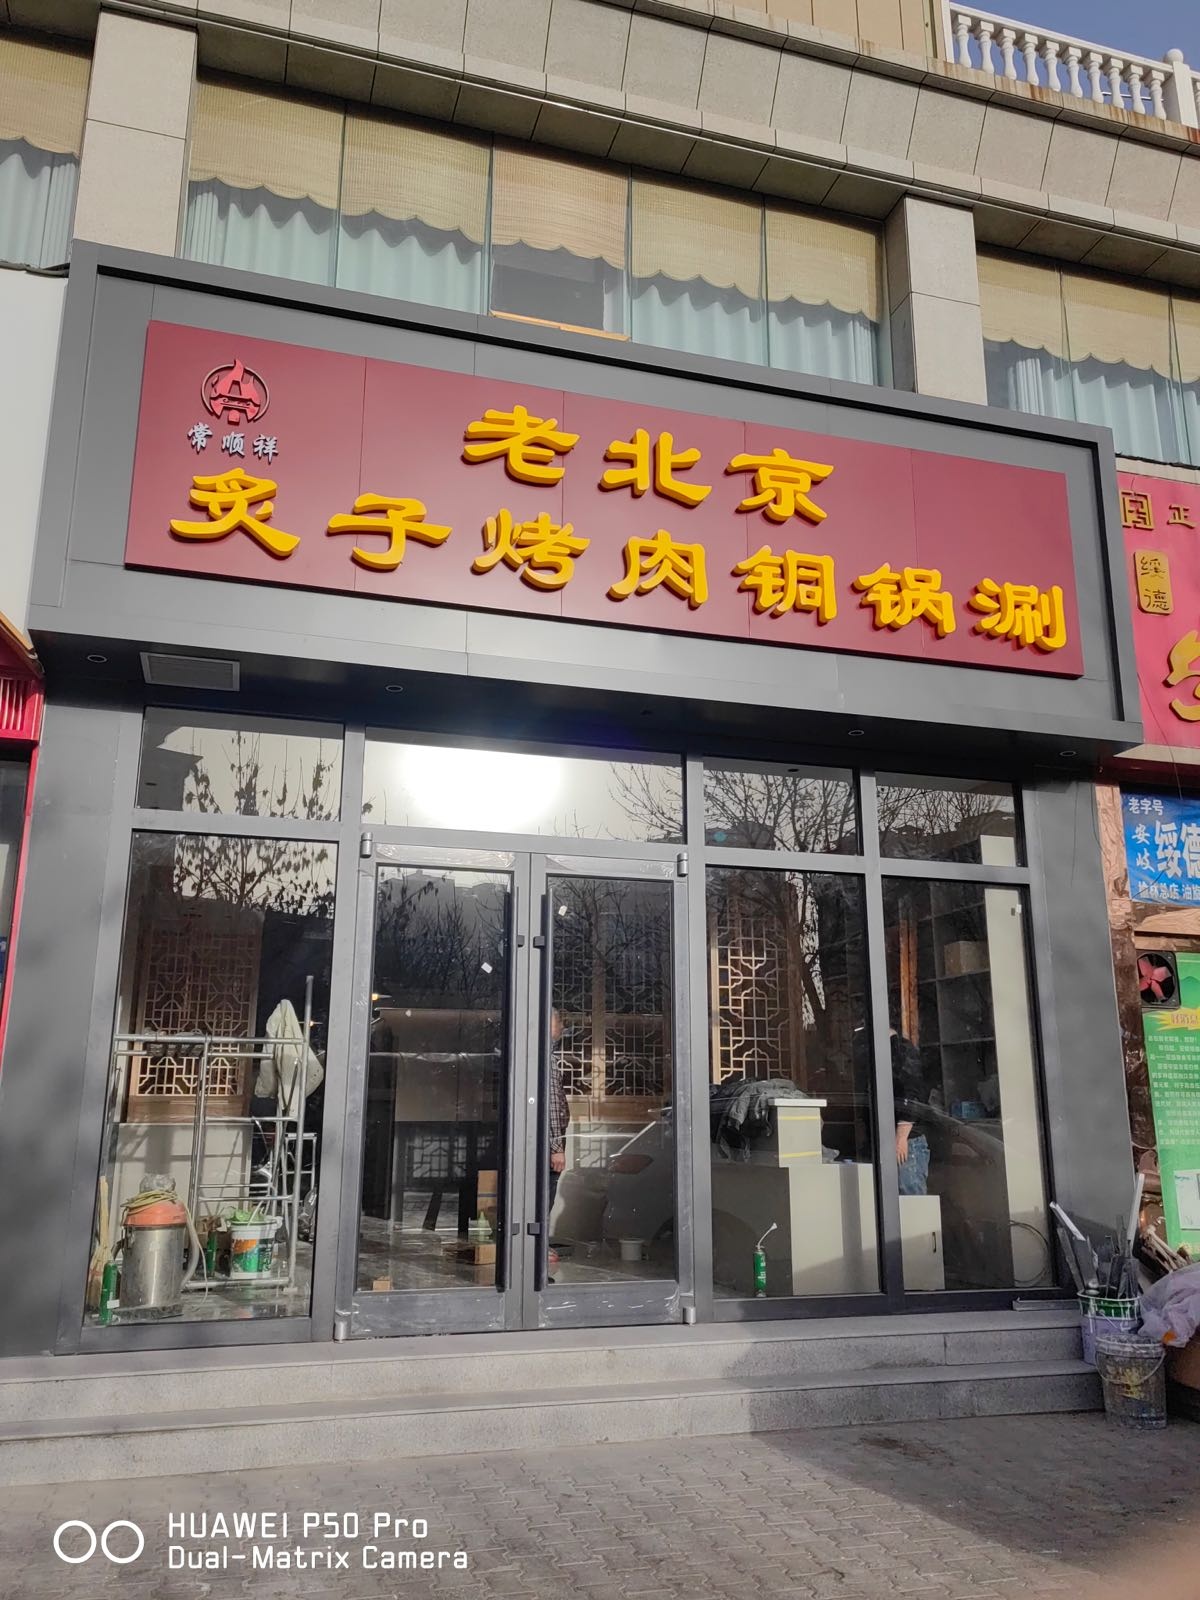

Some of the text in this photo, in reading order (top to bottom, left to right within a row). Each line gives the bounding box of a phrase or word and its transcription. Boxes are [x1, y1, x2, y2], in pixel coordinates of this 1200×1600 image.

[187, 421, 279, 465] 常顺祥
[462, 404, 834, 524] 老北京
[169, 467, 1067, 652] 炙子烤肉铜锅涮
[1128, 797, 1164, 816] 老字号
